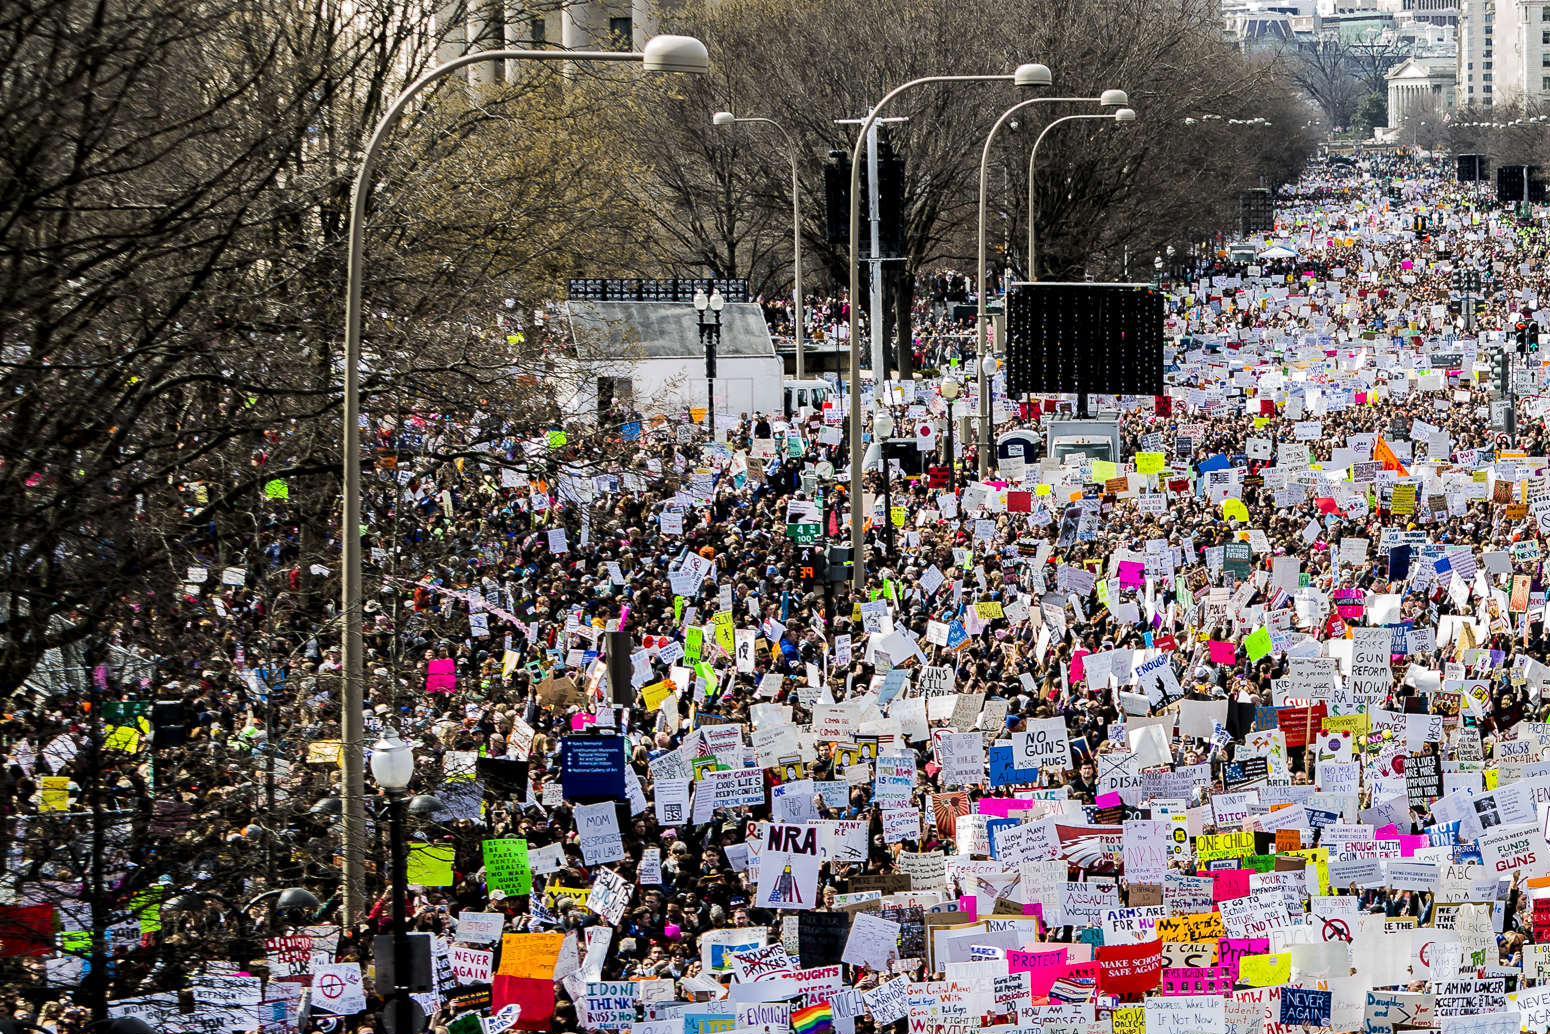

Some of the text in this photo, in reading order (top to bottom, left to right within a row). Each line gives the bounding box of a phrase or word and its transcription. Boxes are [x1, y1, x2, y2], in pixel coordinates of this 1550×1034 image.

[797, 525, 804, 534] 4
[1134, 653, 1170, 677] ENOUGH
[1353, 652, 1385, 664] GUN
[1350, 665, 1388, 678] REFORM
[1025, 730, 1048, 748] NO
[1024, 739, 1066, 758] GUNS
[1040, 754, 1067, 769] HUGS
[768, 825, 818, 854] NRA
[454, 952, 488, 965] NEVER
[1100, 954, 1162, 969] MAKE SCHOOL
[452, 966, 488, 979] AGAIN
[1108, 963, 1158, 977] SAFE AGAIN
[1287, 992, 1323, 1004] NEVER
[1288, 1005, 1323, 1021] AGAIN
